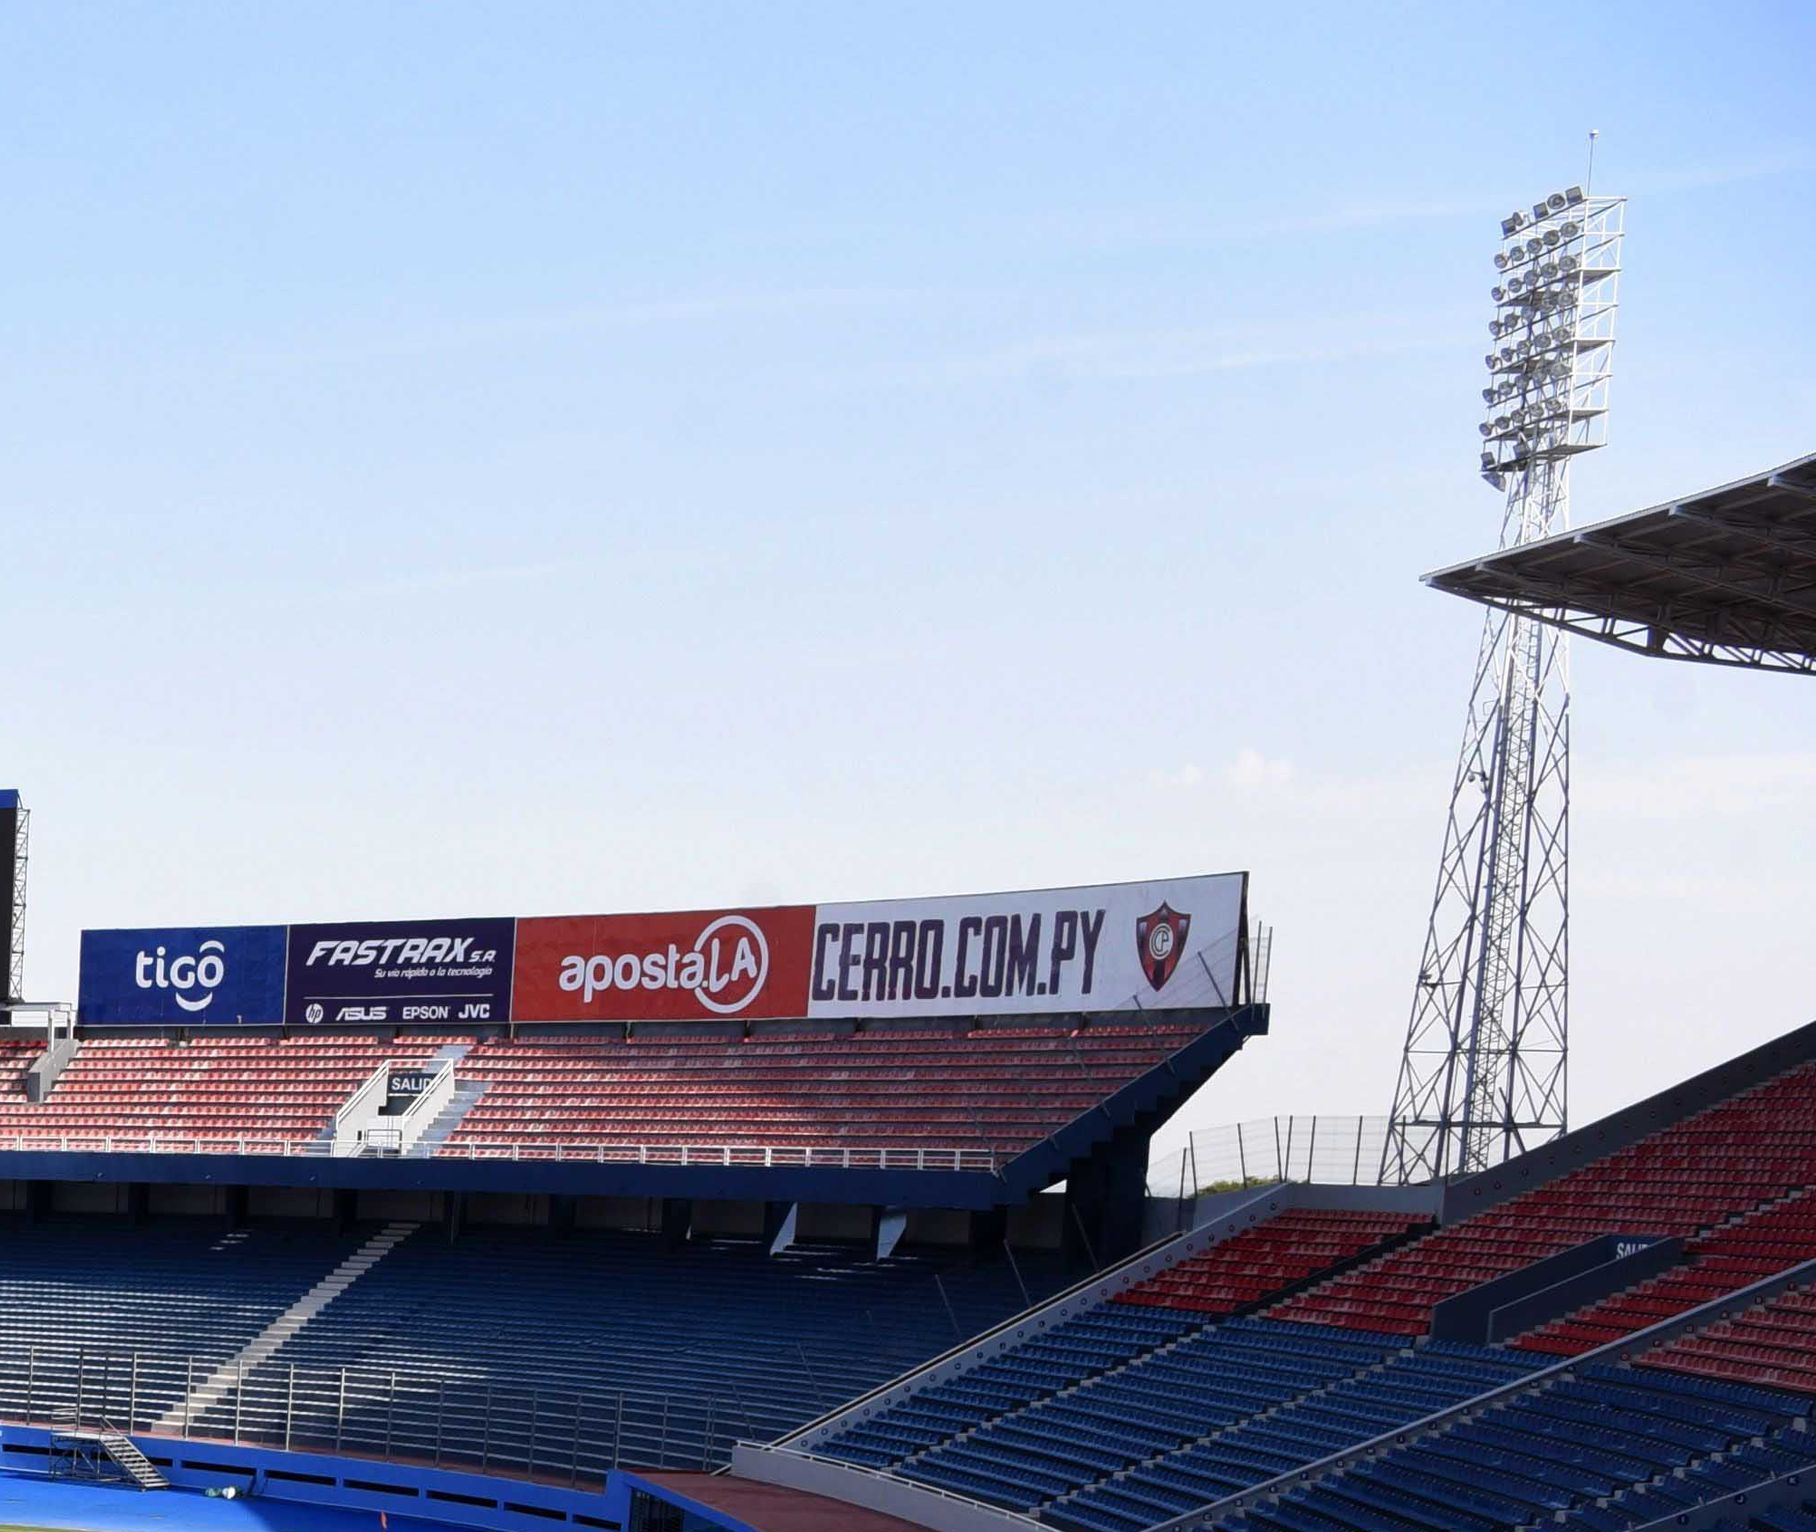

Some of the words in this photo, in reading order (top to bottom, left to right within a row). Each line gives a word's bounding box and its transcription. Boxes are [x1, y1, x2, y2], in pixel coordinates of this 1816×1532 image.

[305, 937, 474, 966] FASTRAX
[811, 909, 1106, 1001] CERRO.COM.PY
[307, 1004, 322, 1023] hp
[335, 1006, 388, 1021] ASUS
[402, 1006, 449, 1020] EPSON
[458, 1004, 490, 1019] JVC
[391, 1077, 433, 1091] SALID
